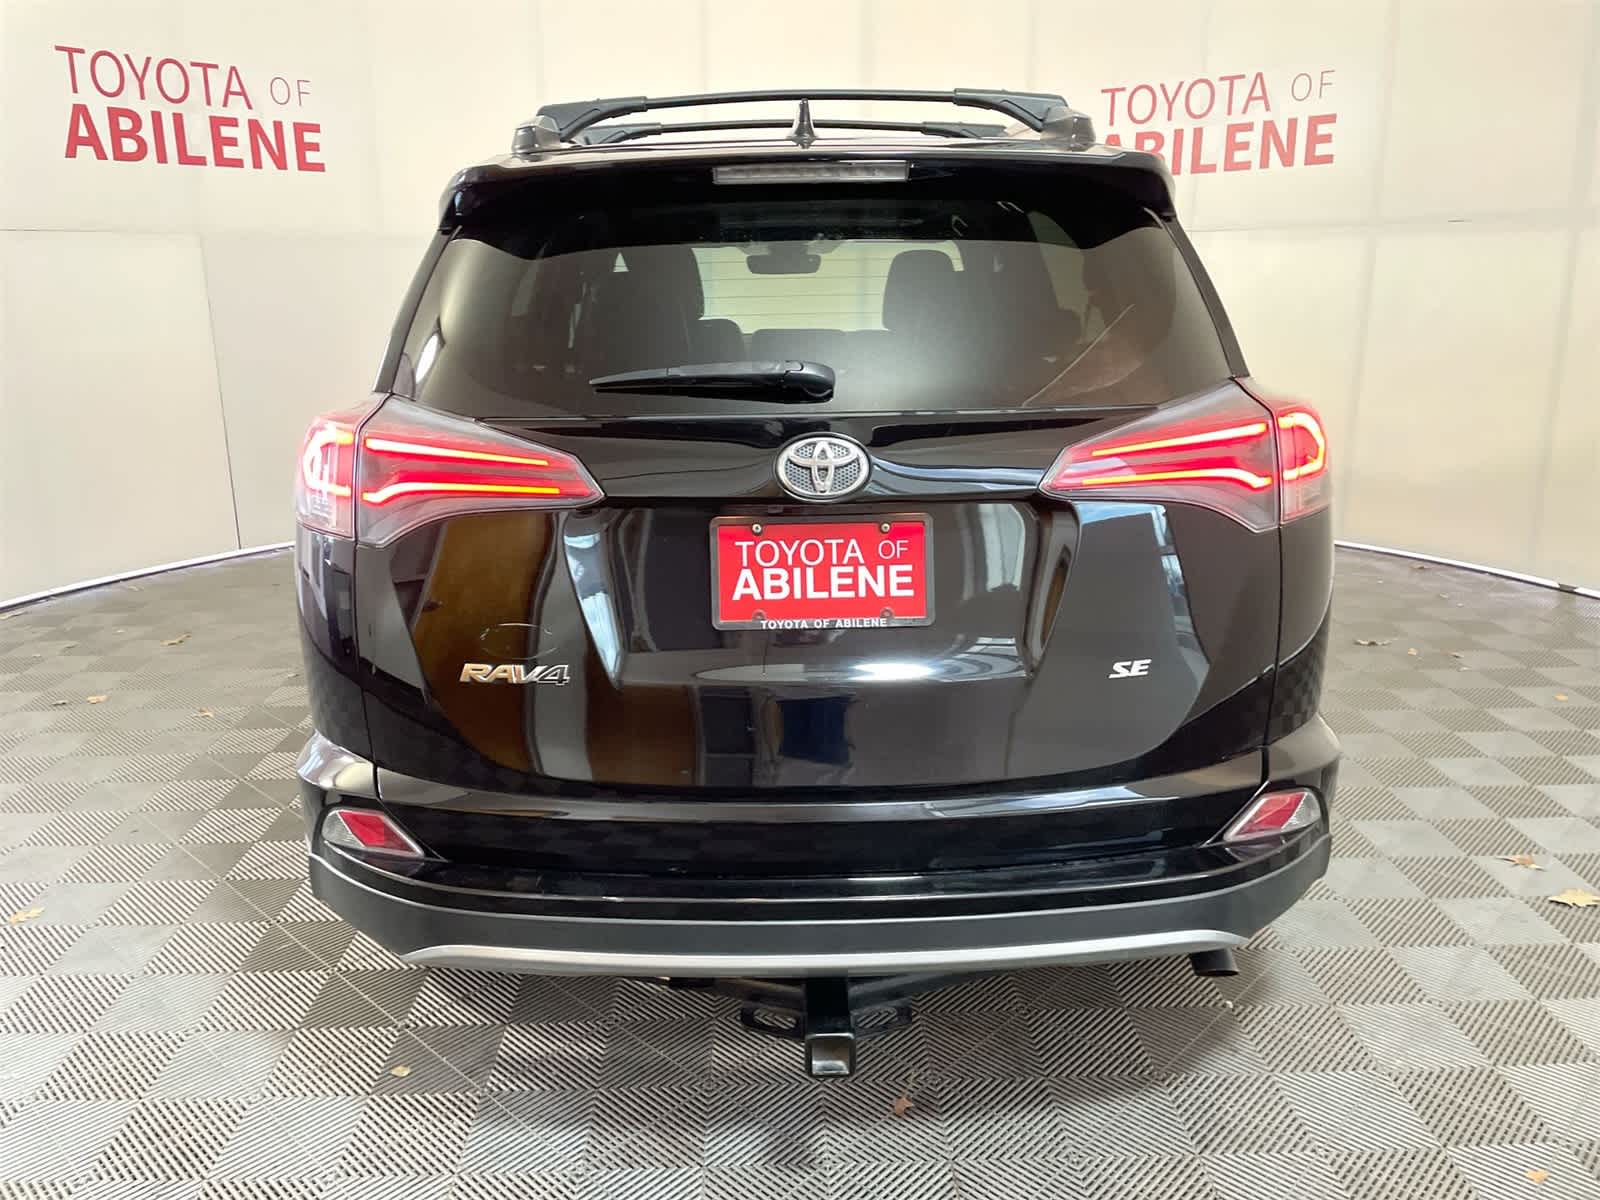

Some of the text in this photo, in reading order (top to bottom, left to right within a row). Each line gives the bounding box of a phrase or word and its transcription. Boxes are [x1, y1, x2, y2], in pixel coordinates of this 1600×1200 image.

[54, 45, 311, 110] TOYOTA OF
[1101, 69, 1336, 127] TOYOTA OF
[64, 103, 326, 172] ABILENE
[735, 539, 909, 567] TOYOTA OF
[732, 564, 914, 600] ABILENE
[760, 617, 888, 630] TOYOTA OF ABILENE
[459, 662, 571, 686] RAV4
[1108, 659, 1152, 679] SE
